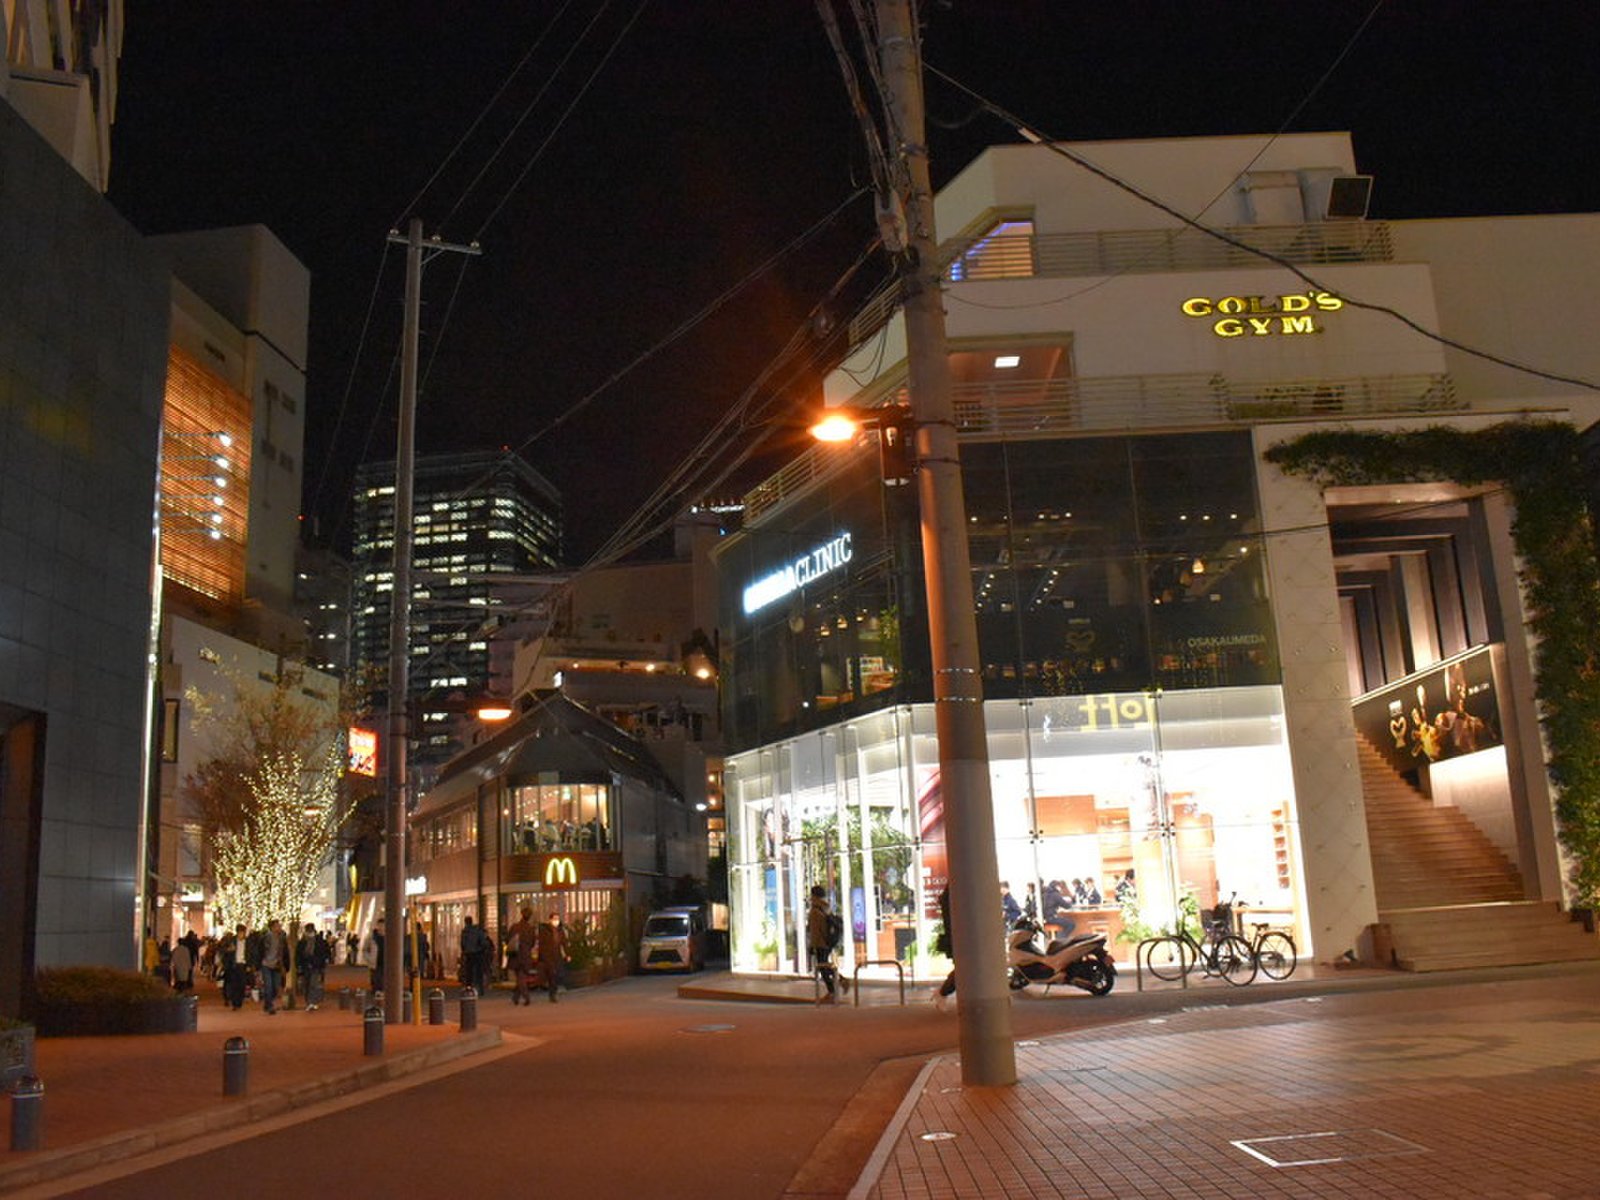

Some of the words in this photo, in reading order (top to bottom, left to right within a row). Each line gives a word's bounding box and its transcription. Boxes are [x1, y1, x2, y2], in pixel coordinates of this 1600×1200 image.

[1181, 292, 1344, 317] GOLD'S
[1213, 315, 1315, 337] GYM
[794, 532, 853, 588] CLINIC
